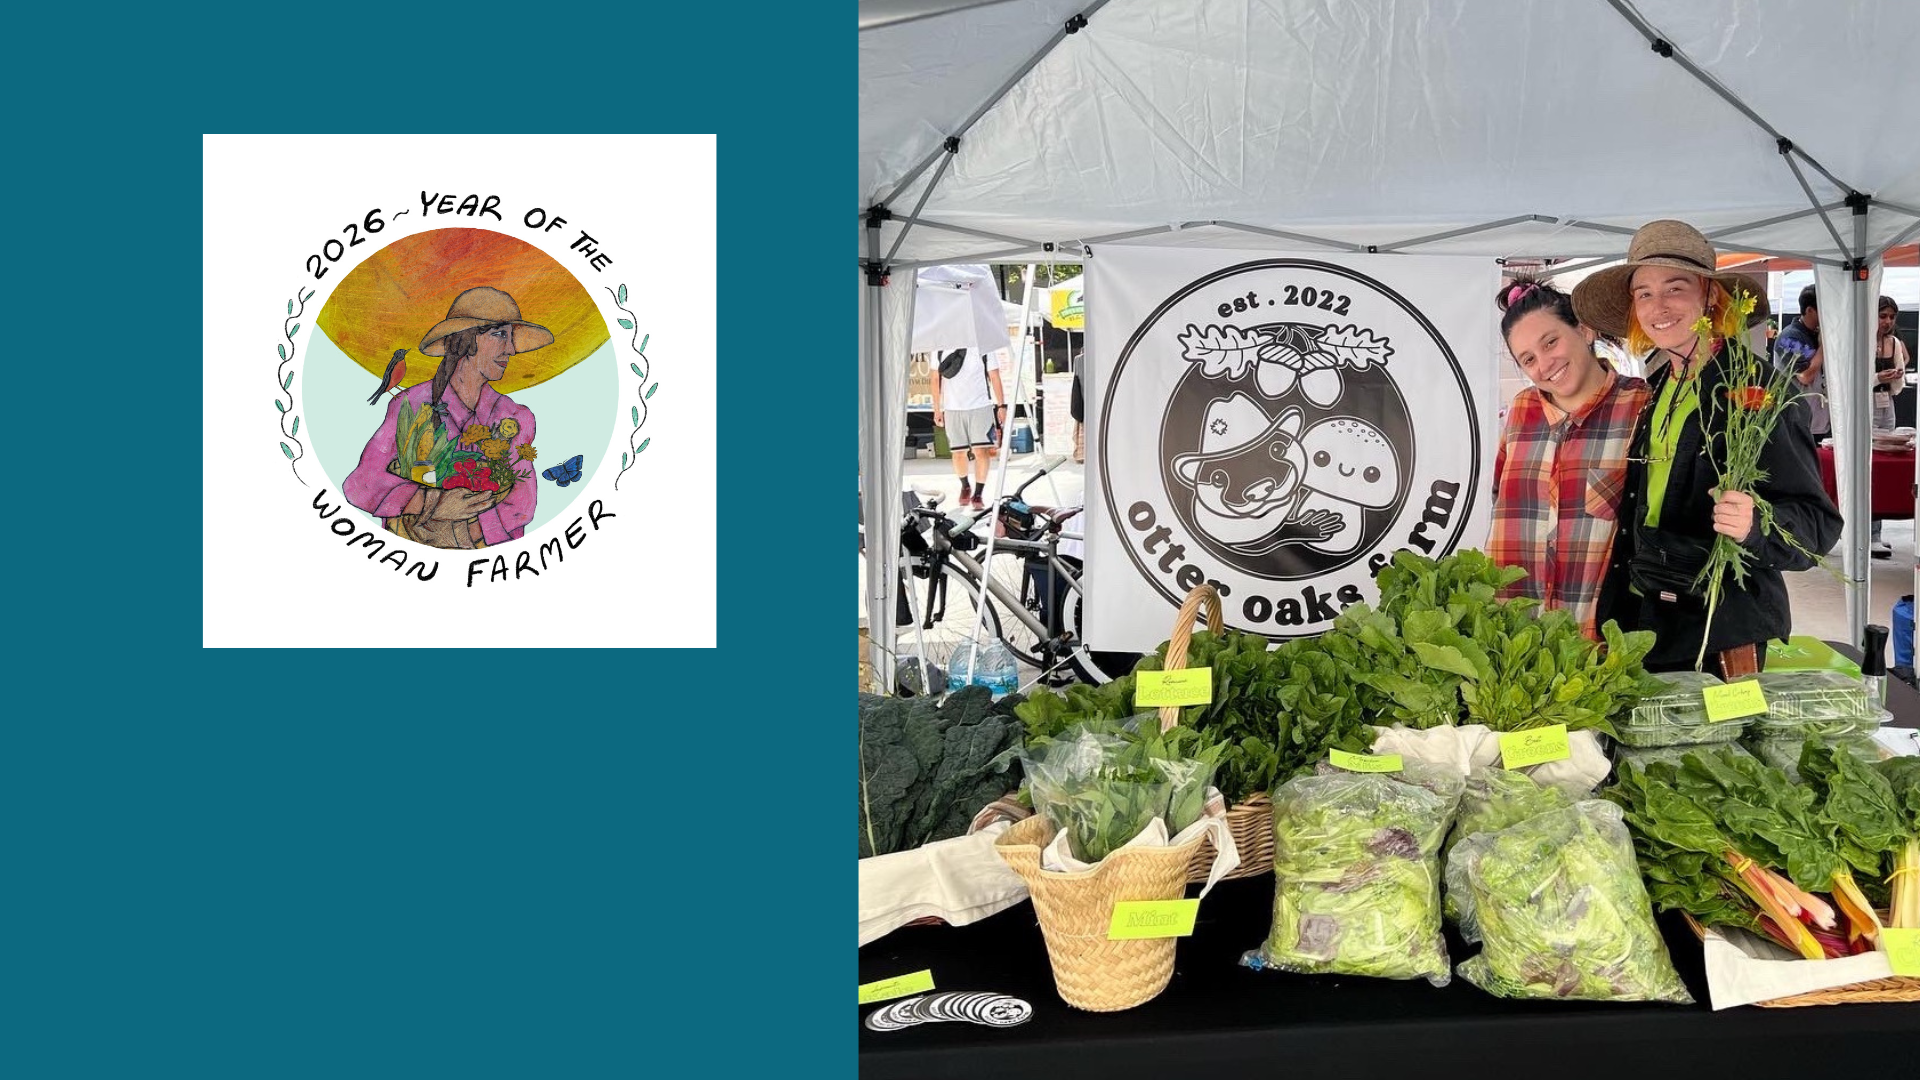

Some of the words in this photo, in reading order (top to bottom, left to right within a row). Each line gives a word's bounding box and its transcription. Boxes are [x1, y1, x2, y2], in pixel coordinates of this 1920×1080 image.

[1217, 291, 1260, 319] est
[1283, 284, 1353, 318] 2022
[1127, 500, 1232, 598] otter
[1242, 584, 1365, 626] oaks
[1123, 910, 1179, 928] Mint
